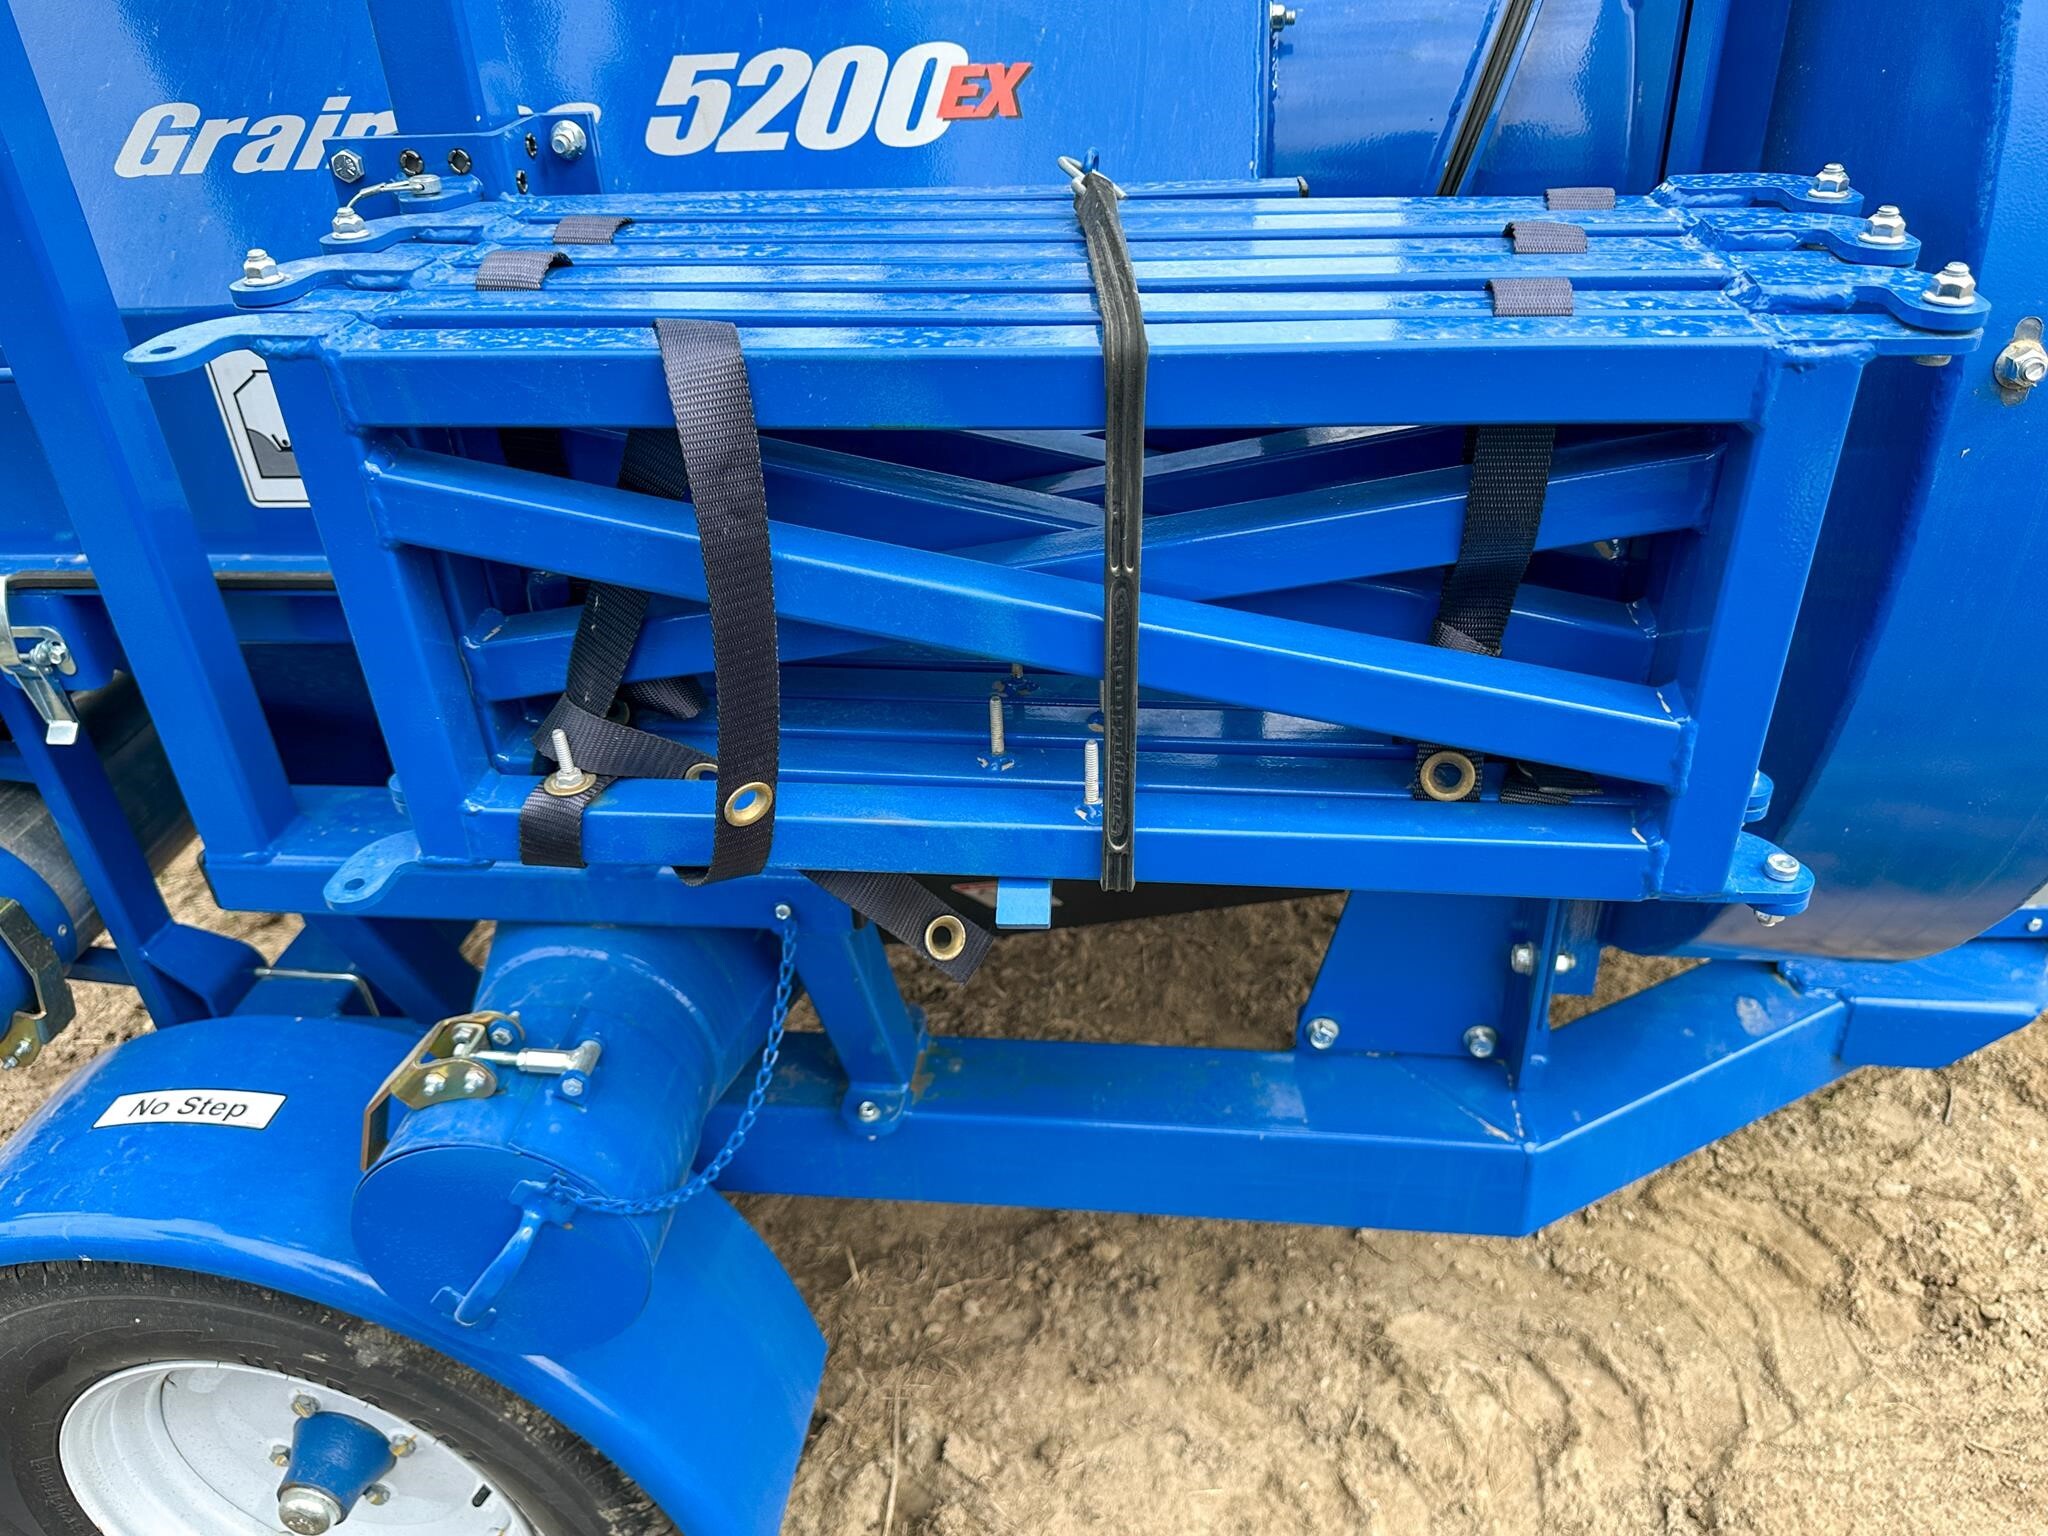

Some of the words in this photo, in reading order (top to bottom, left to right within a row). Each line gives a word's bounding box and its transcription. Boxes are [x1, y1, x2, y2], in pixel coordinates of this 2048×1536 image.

[644, 41, 969, 156] 5200
[936, 61, 1034, 121] EX
[128, 1098, 170, 1117] No
[177, 1096, 248, 1121] Step
